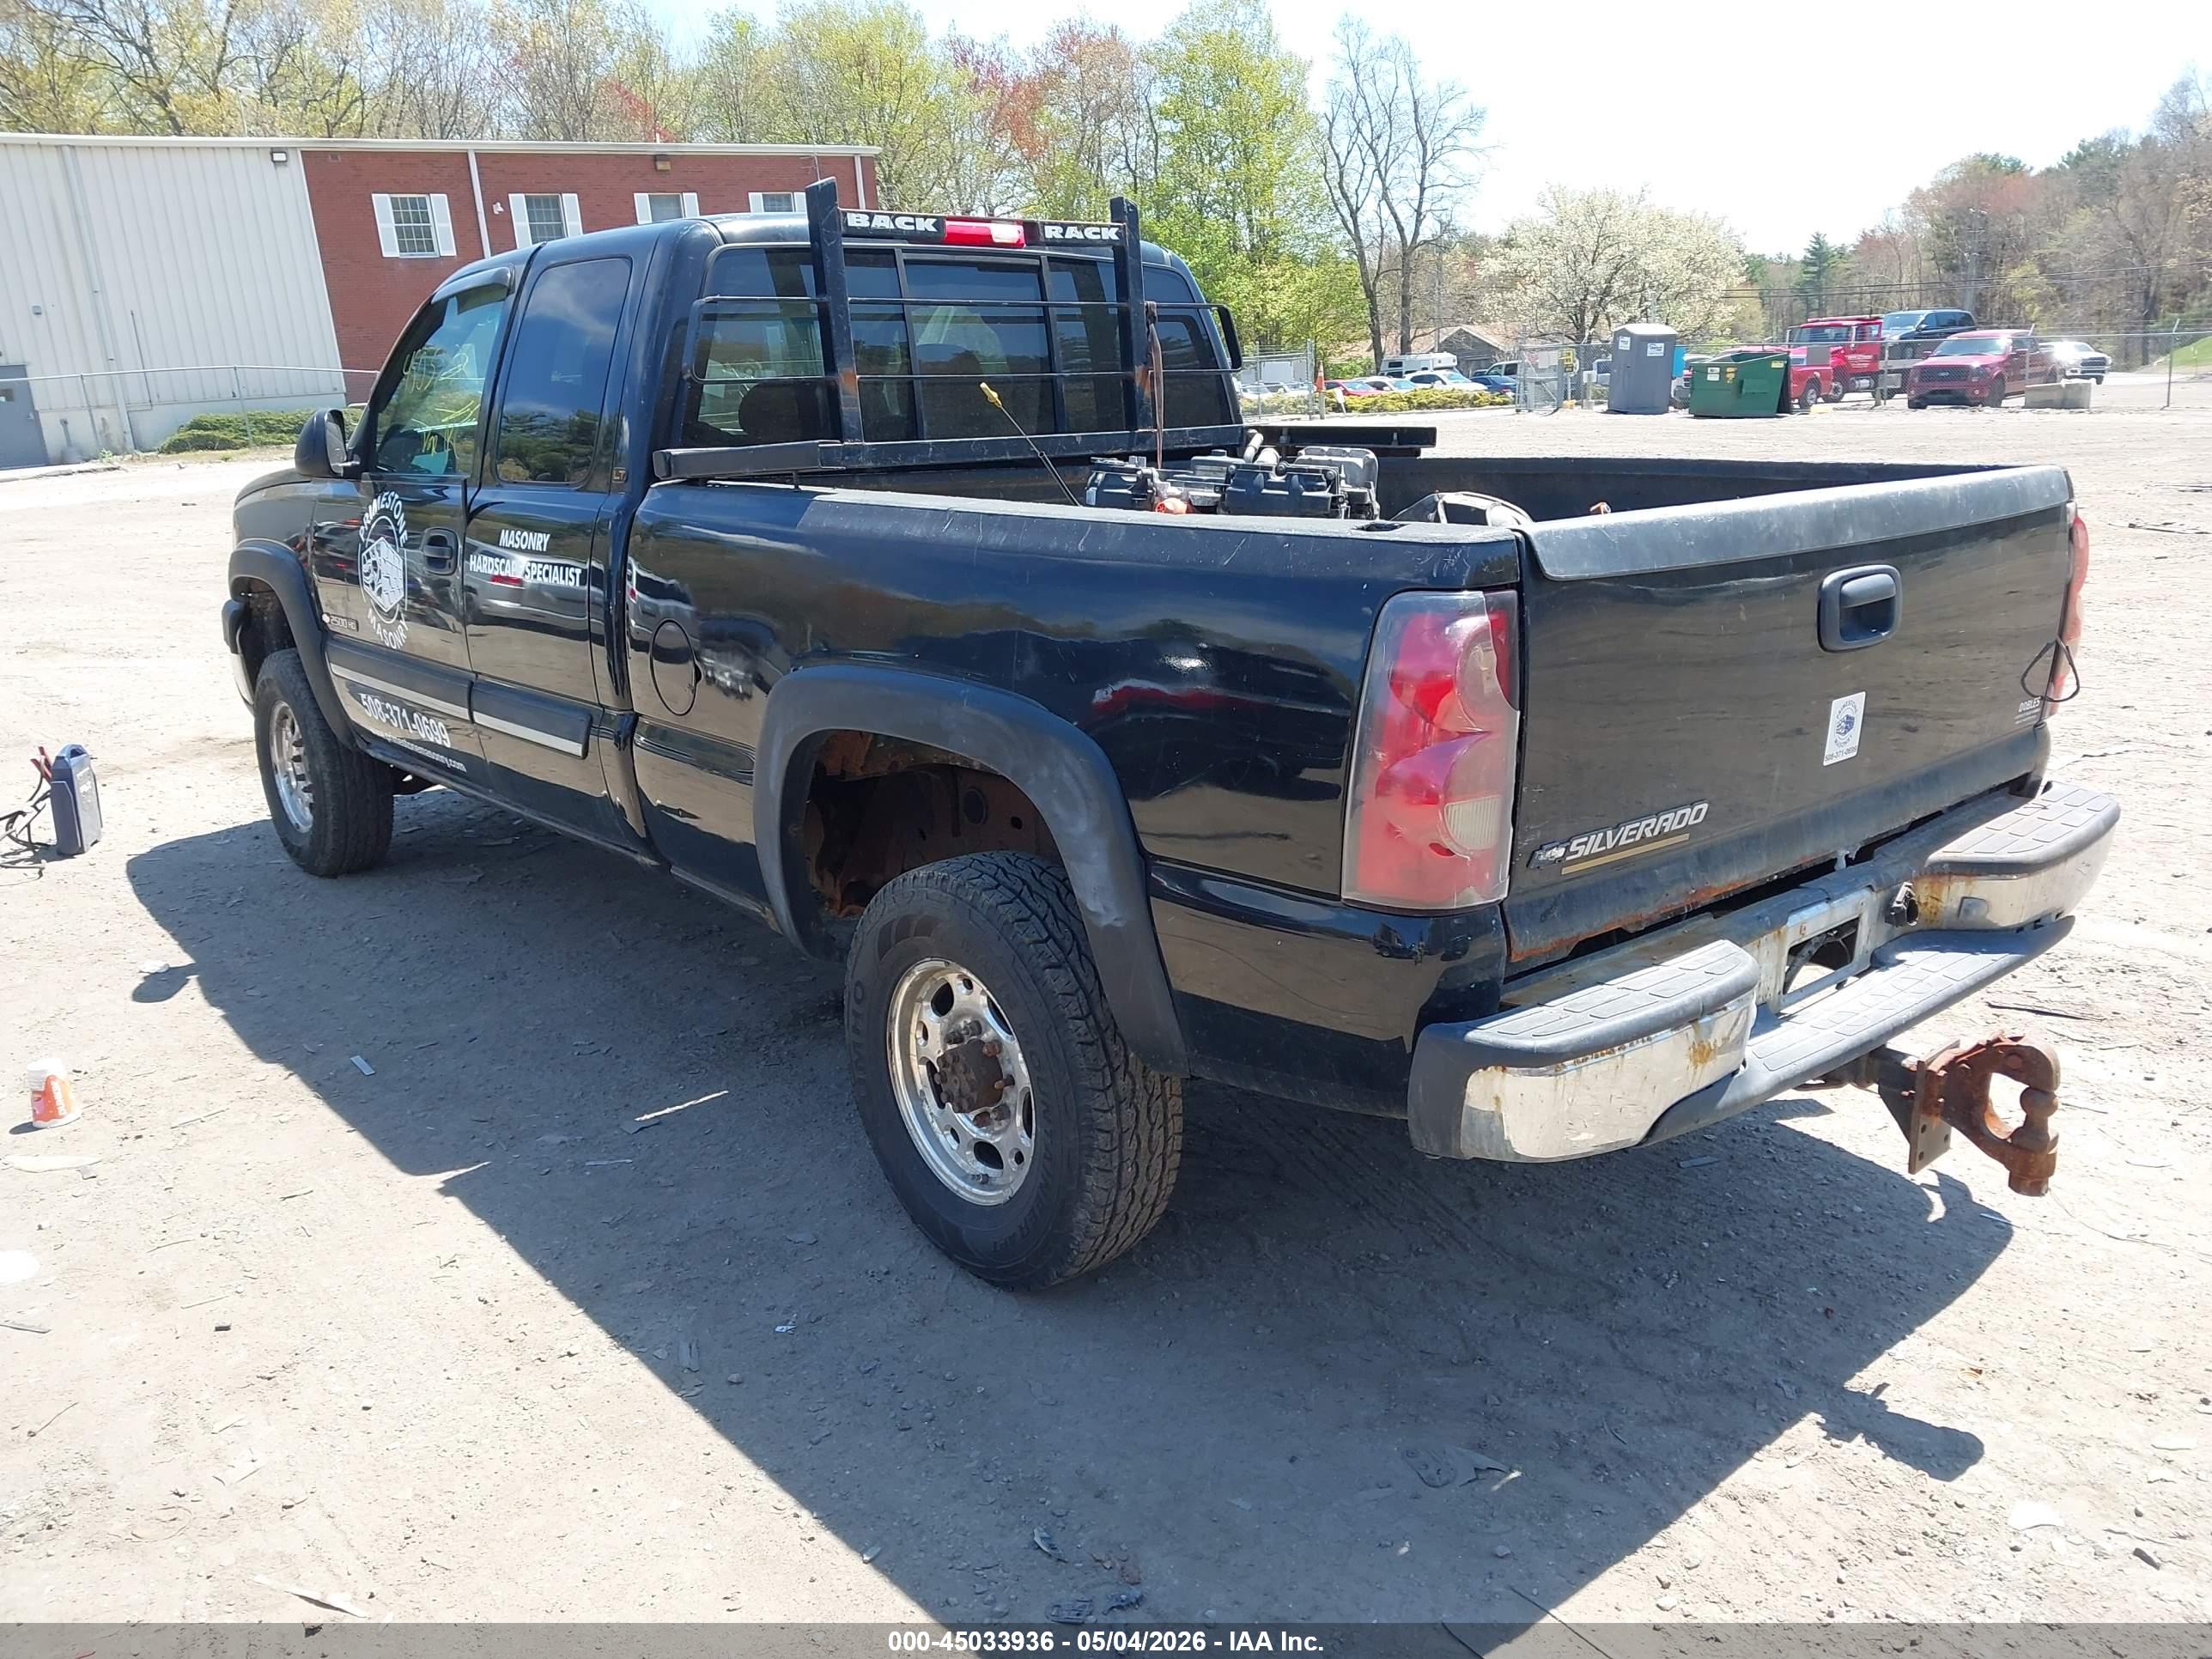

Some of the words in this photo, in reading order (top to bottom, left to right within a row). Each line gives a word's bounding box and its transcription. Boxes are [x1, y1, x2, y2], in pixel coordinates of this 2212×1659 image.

[847, 213, 937, 232] BACK
[1044, 225, 1120, 240] RACK
[500, 529, 550, 551] MASONRY
[524, 562, 581, 586] SPECIALIST
[331, 616, 347, 629] 2500
[368, 608, 408, 649] MASONRY
[359, 693, 451, 748] 508-371-0699
[1565, 801, 1709, 861] SILVERADO
